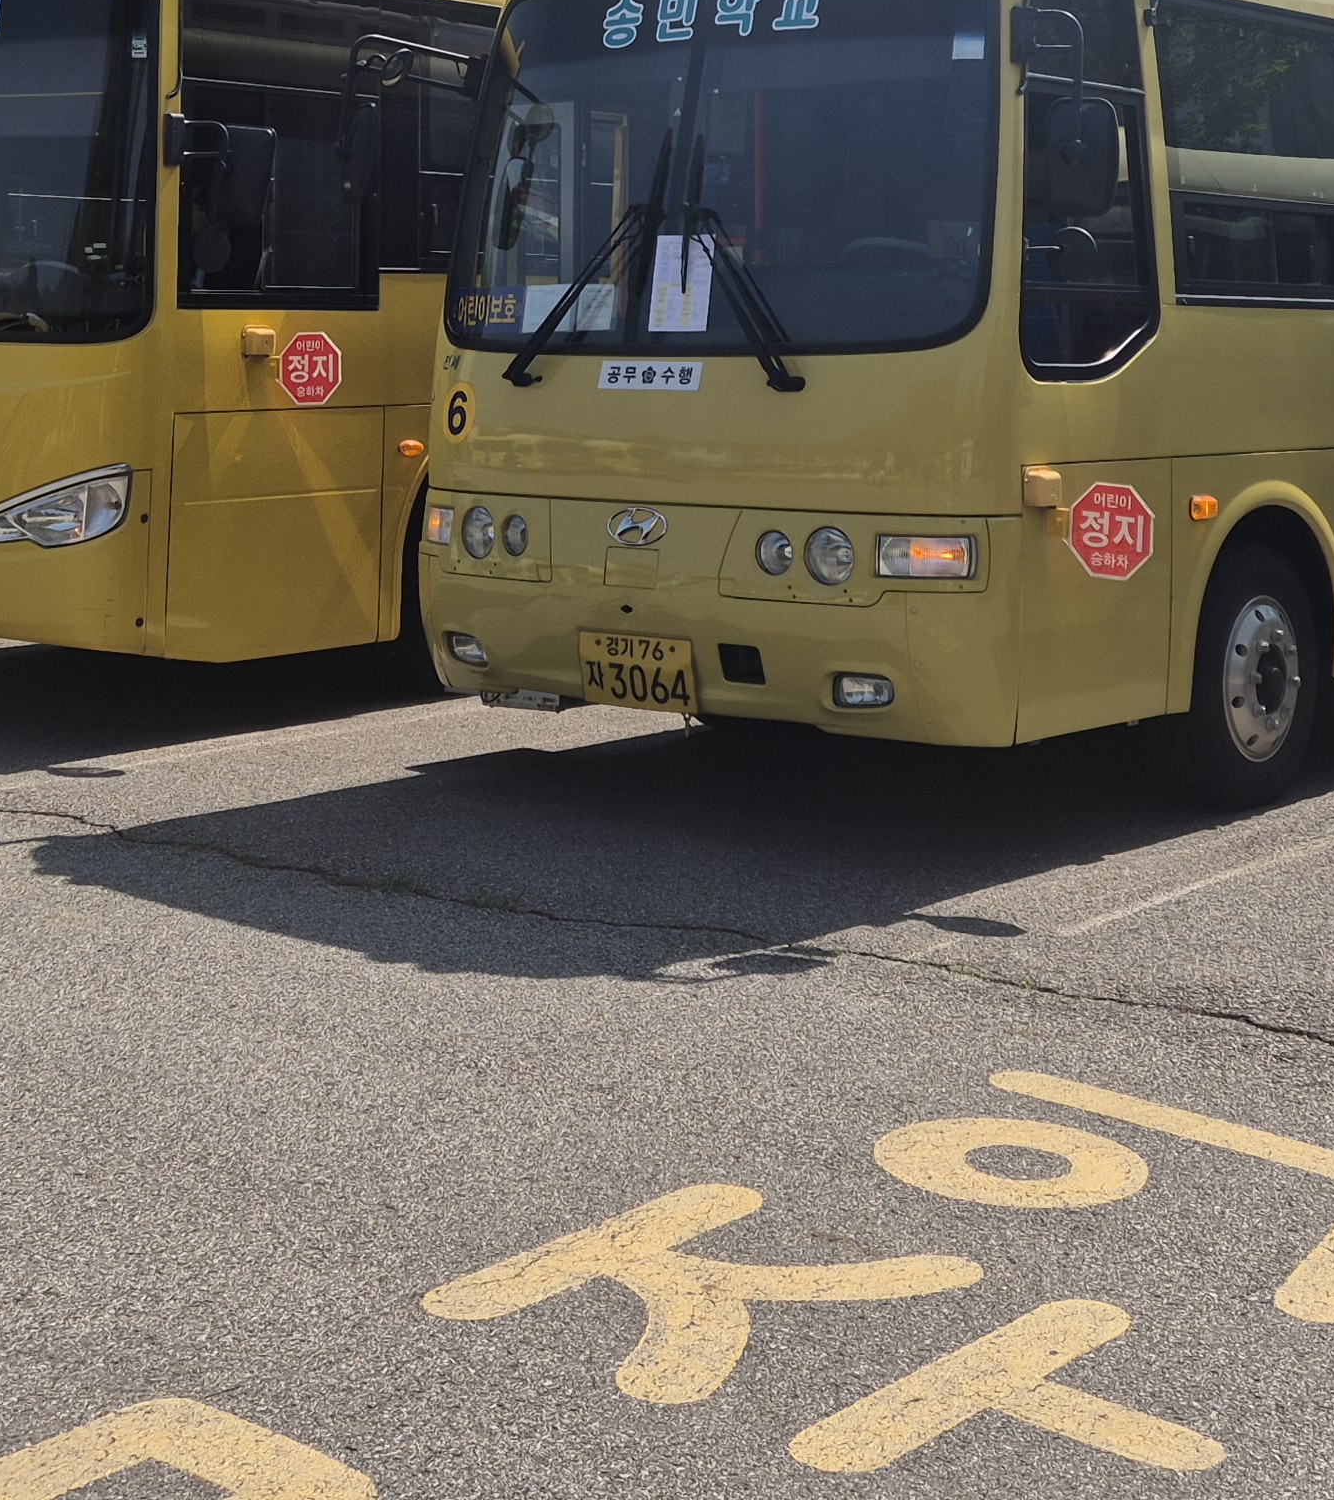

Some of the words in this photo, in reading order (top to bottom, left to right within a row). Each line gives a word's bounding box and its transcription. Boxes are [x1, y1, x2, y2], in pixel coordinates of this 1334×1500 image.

[458, 293, 517, 327] 어린이보호
[296, 340, 324, 352] 어린이
[287, 354, 334, 383] 정지
[607, 366, 637, 384] 공무
[661, 366, 693, 385] 수행
[296, 385, 324, 398] 승하차
[447, 390, 468, 436] 6
[1093, 492, 1132, 511] 어린이
[1079, 510, 1144, 553] 정지
[1090, 551, 1129, 570] 승하차
[585, 660, 691, 707] 자3064
